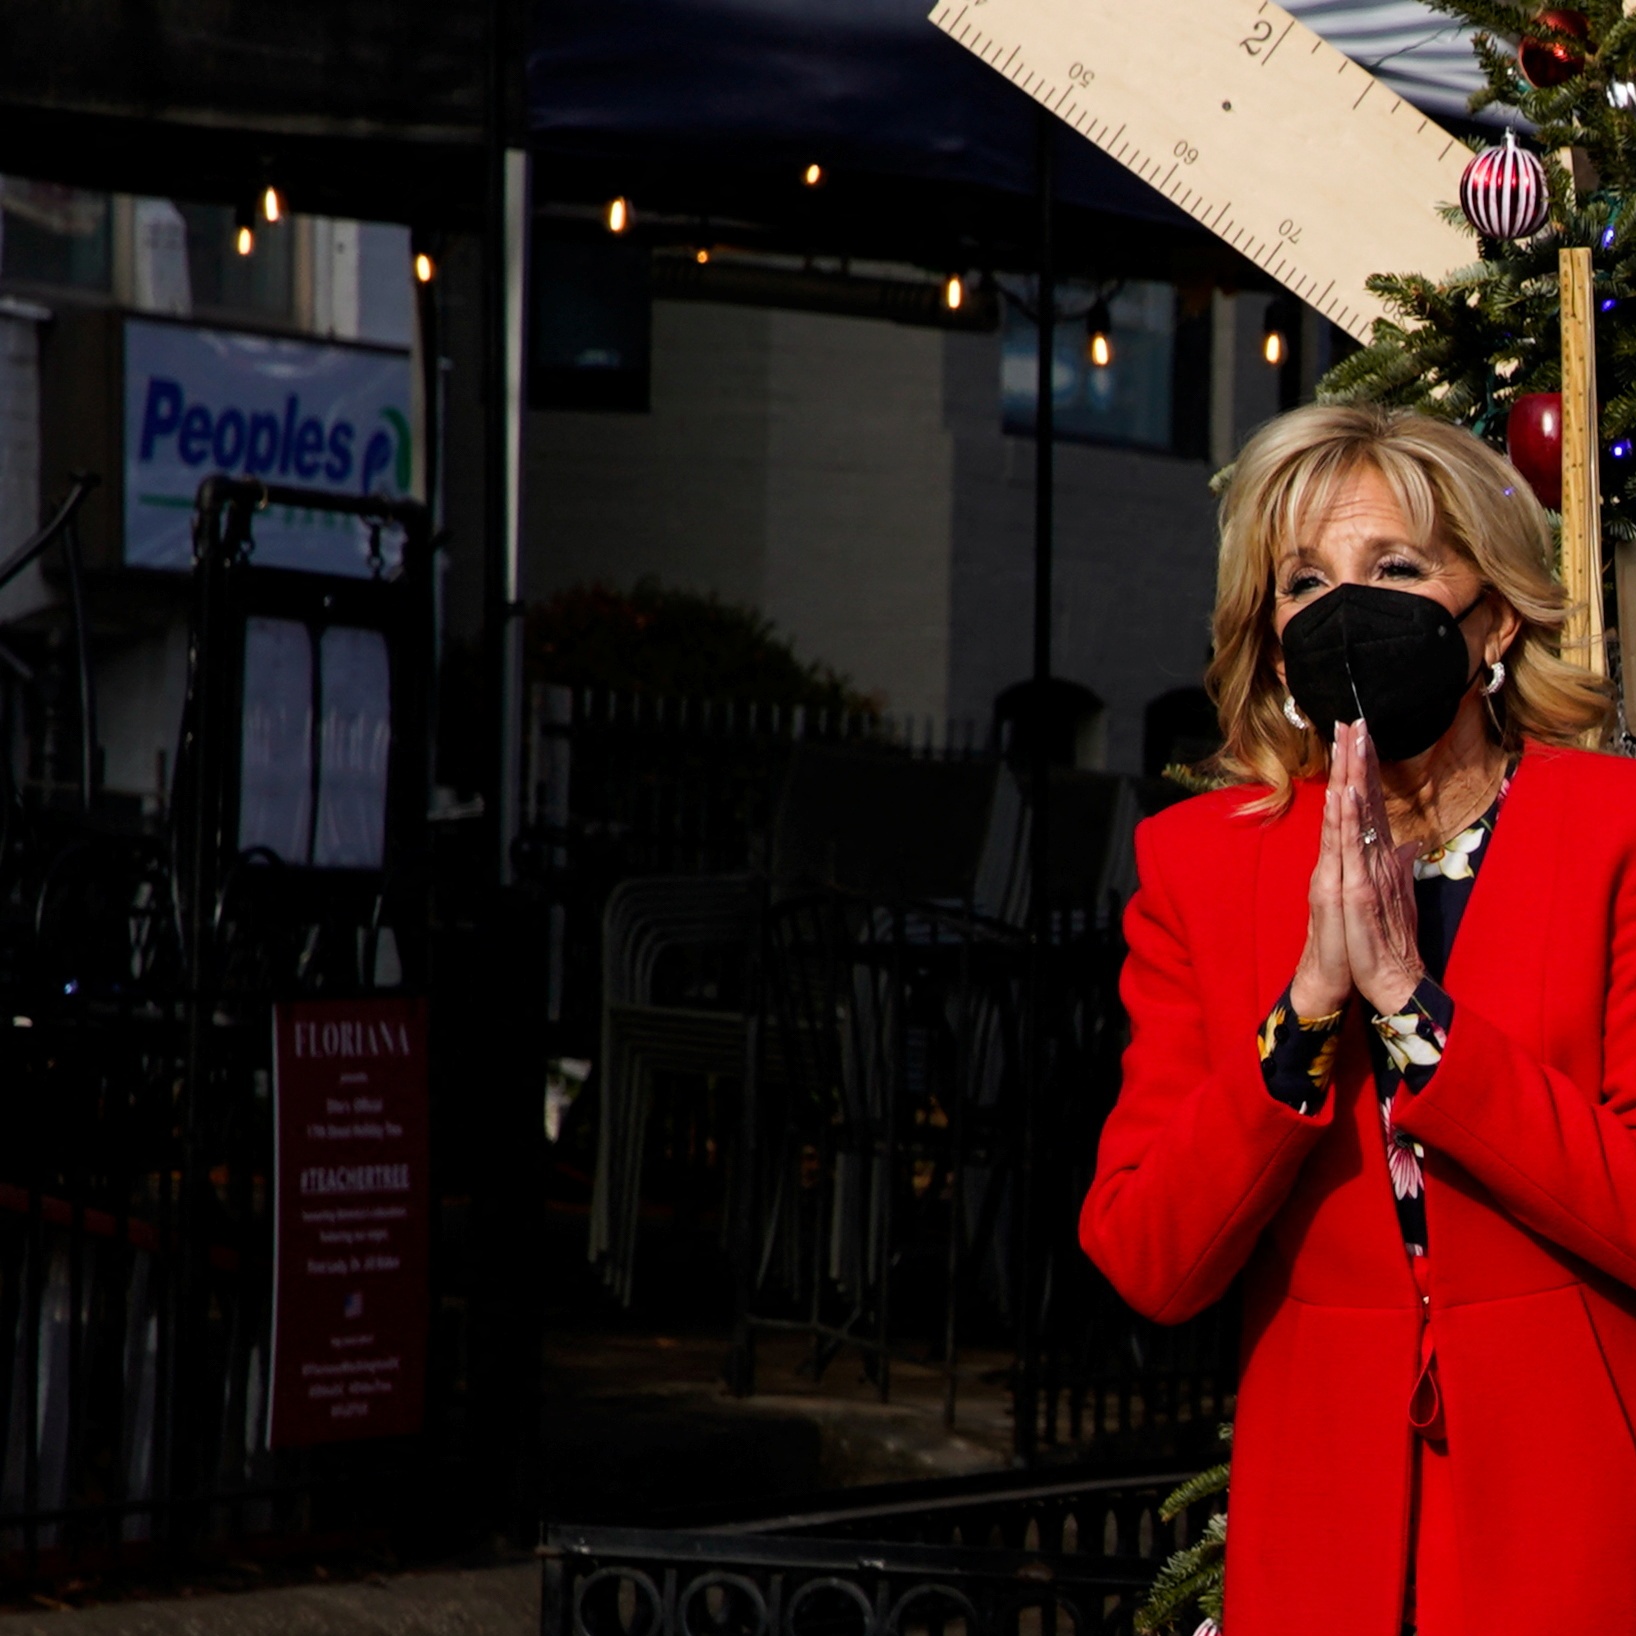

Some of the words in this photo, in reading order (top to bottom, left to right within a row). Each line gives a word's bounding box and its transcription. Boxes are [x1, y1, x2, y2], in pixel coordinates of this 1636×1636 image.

[1067, 62, 1095, 88] 50
[1278, 218, 1304, 245] 70
[139, 375, 354, 481] Peoples
[294, 1020, 410, 1058] FLORIANA
